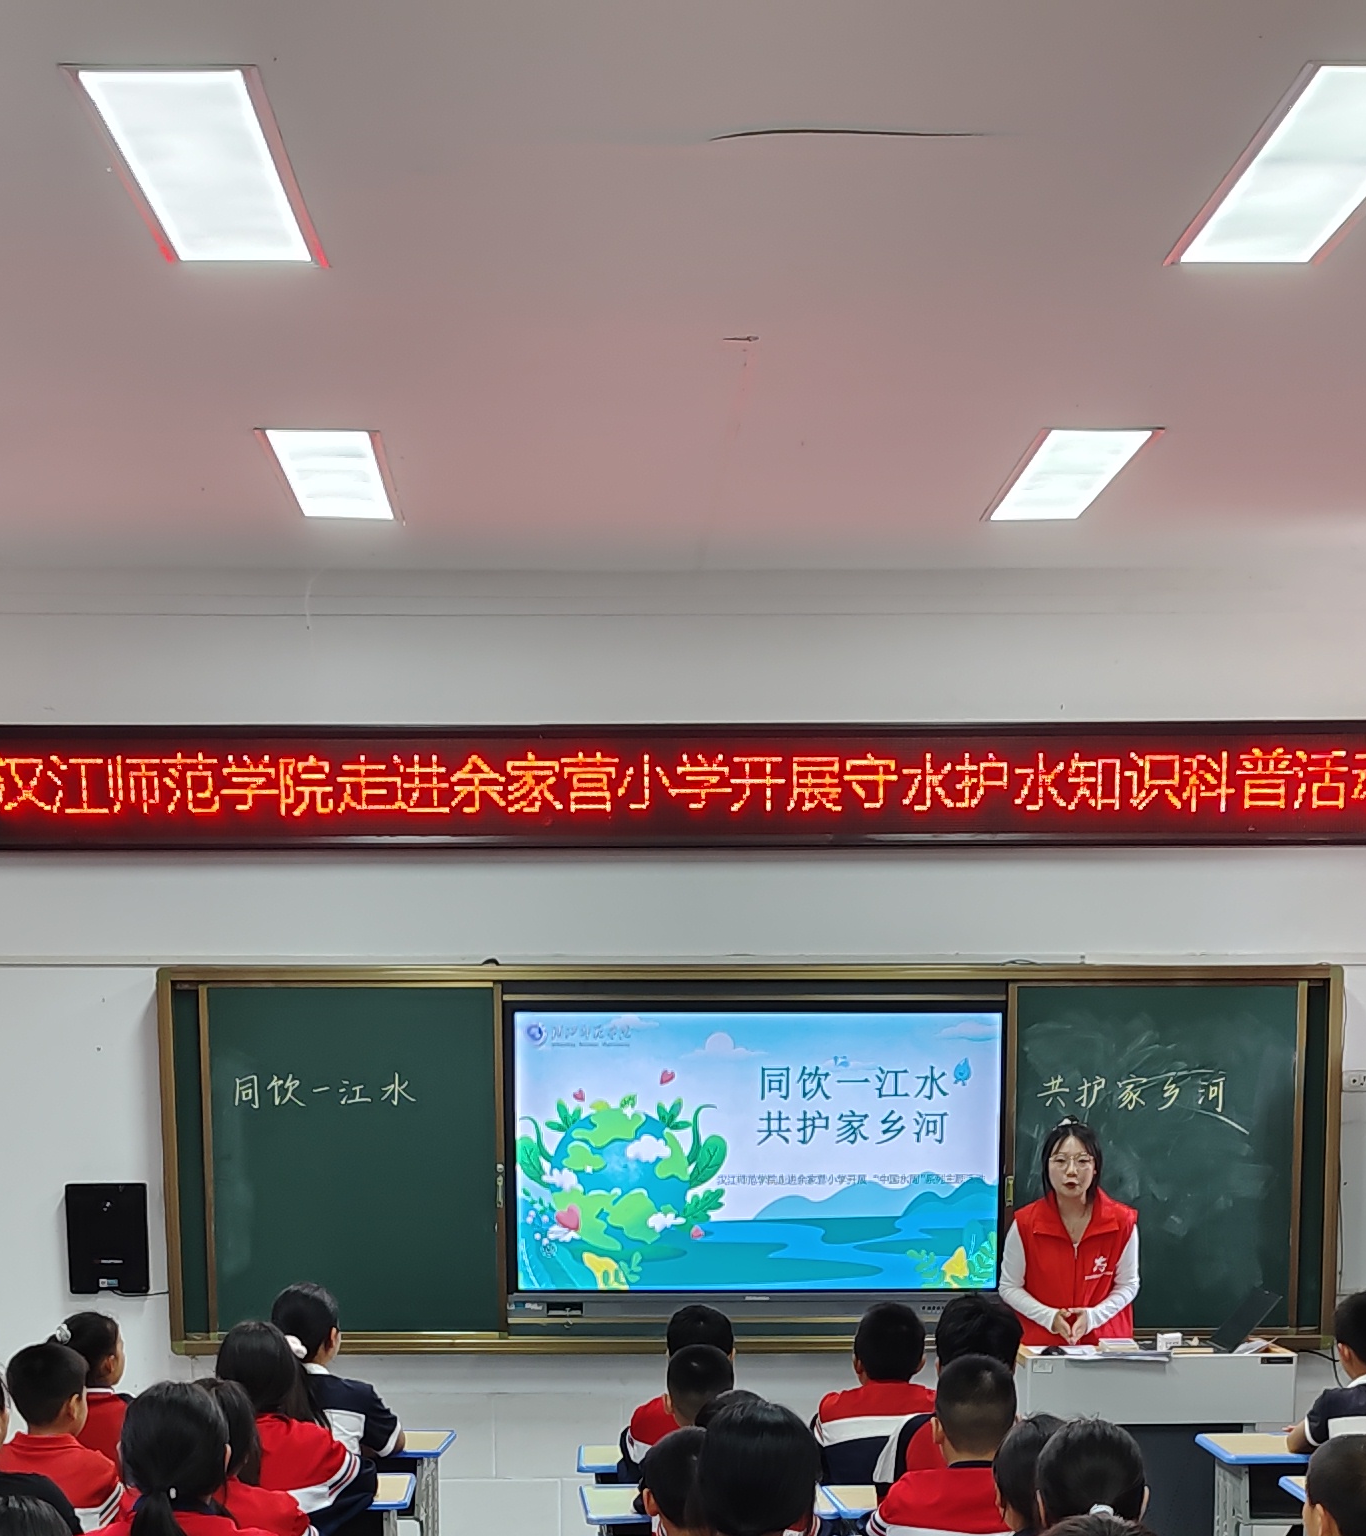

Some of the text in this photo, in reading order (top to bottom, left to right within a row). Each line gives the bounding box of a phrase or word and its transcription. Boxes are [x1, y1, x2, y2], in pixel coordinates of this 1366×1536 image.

[233, 1072, 417, 1109] 同饮一江水
[760, 1065, 949, 1101] 同饮一江水
[1037, 1074, 1227, 1113] 共护家乡河
[757, 1110, 949, 1145] 共护家乡河
